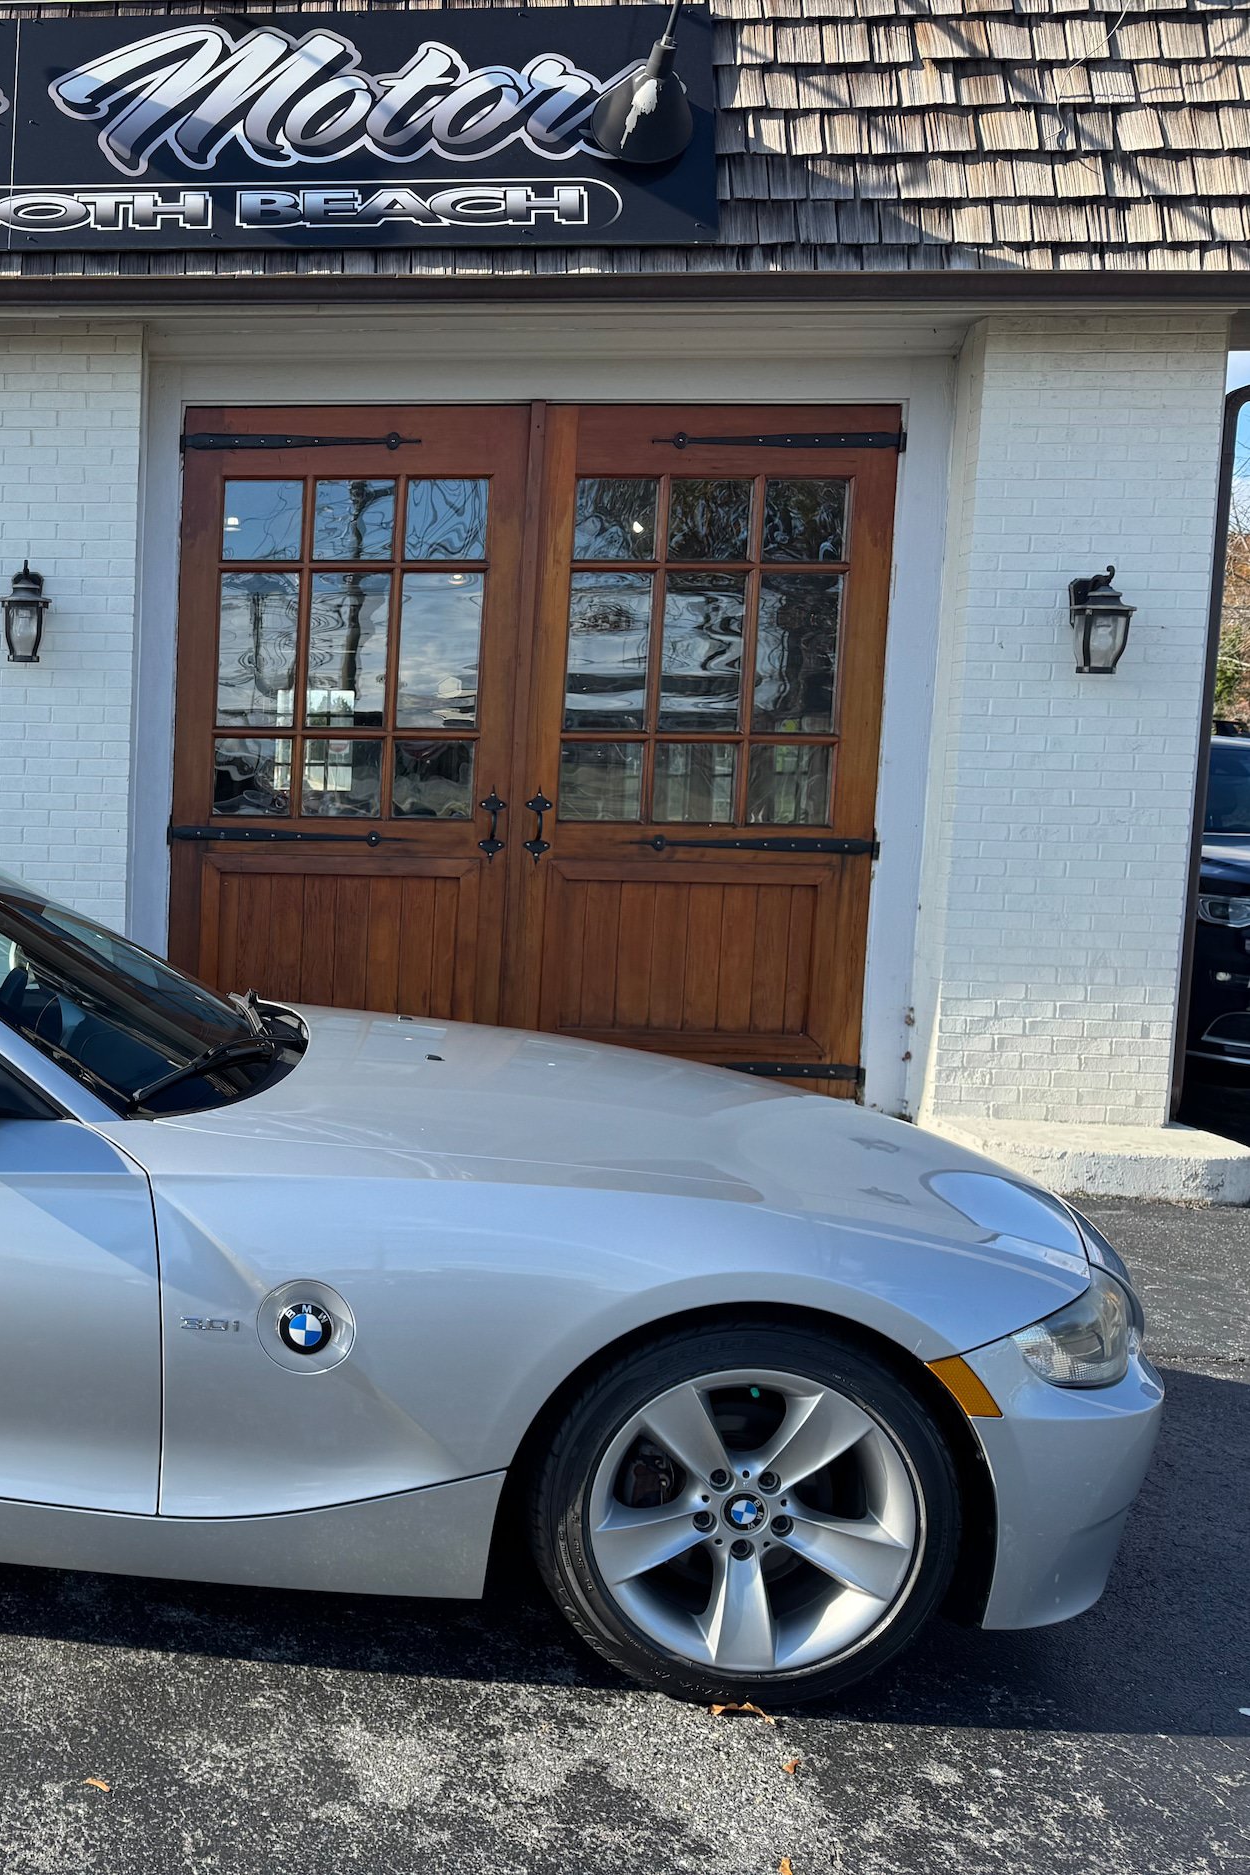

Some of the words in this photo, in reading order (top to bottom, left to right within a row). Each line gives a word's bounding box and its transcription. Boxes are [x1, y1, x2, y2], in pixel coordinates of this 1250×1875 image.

[48, 24, 688, 177] Motor
[235, 185, 588, 229] BEACH
[285, 1304, 329, 1324] BMW
[748, 1500, 764, 1531] BMW
